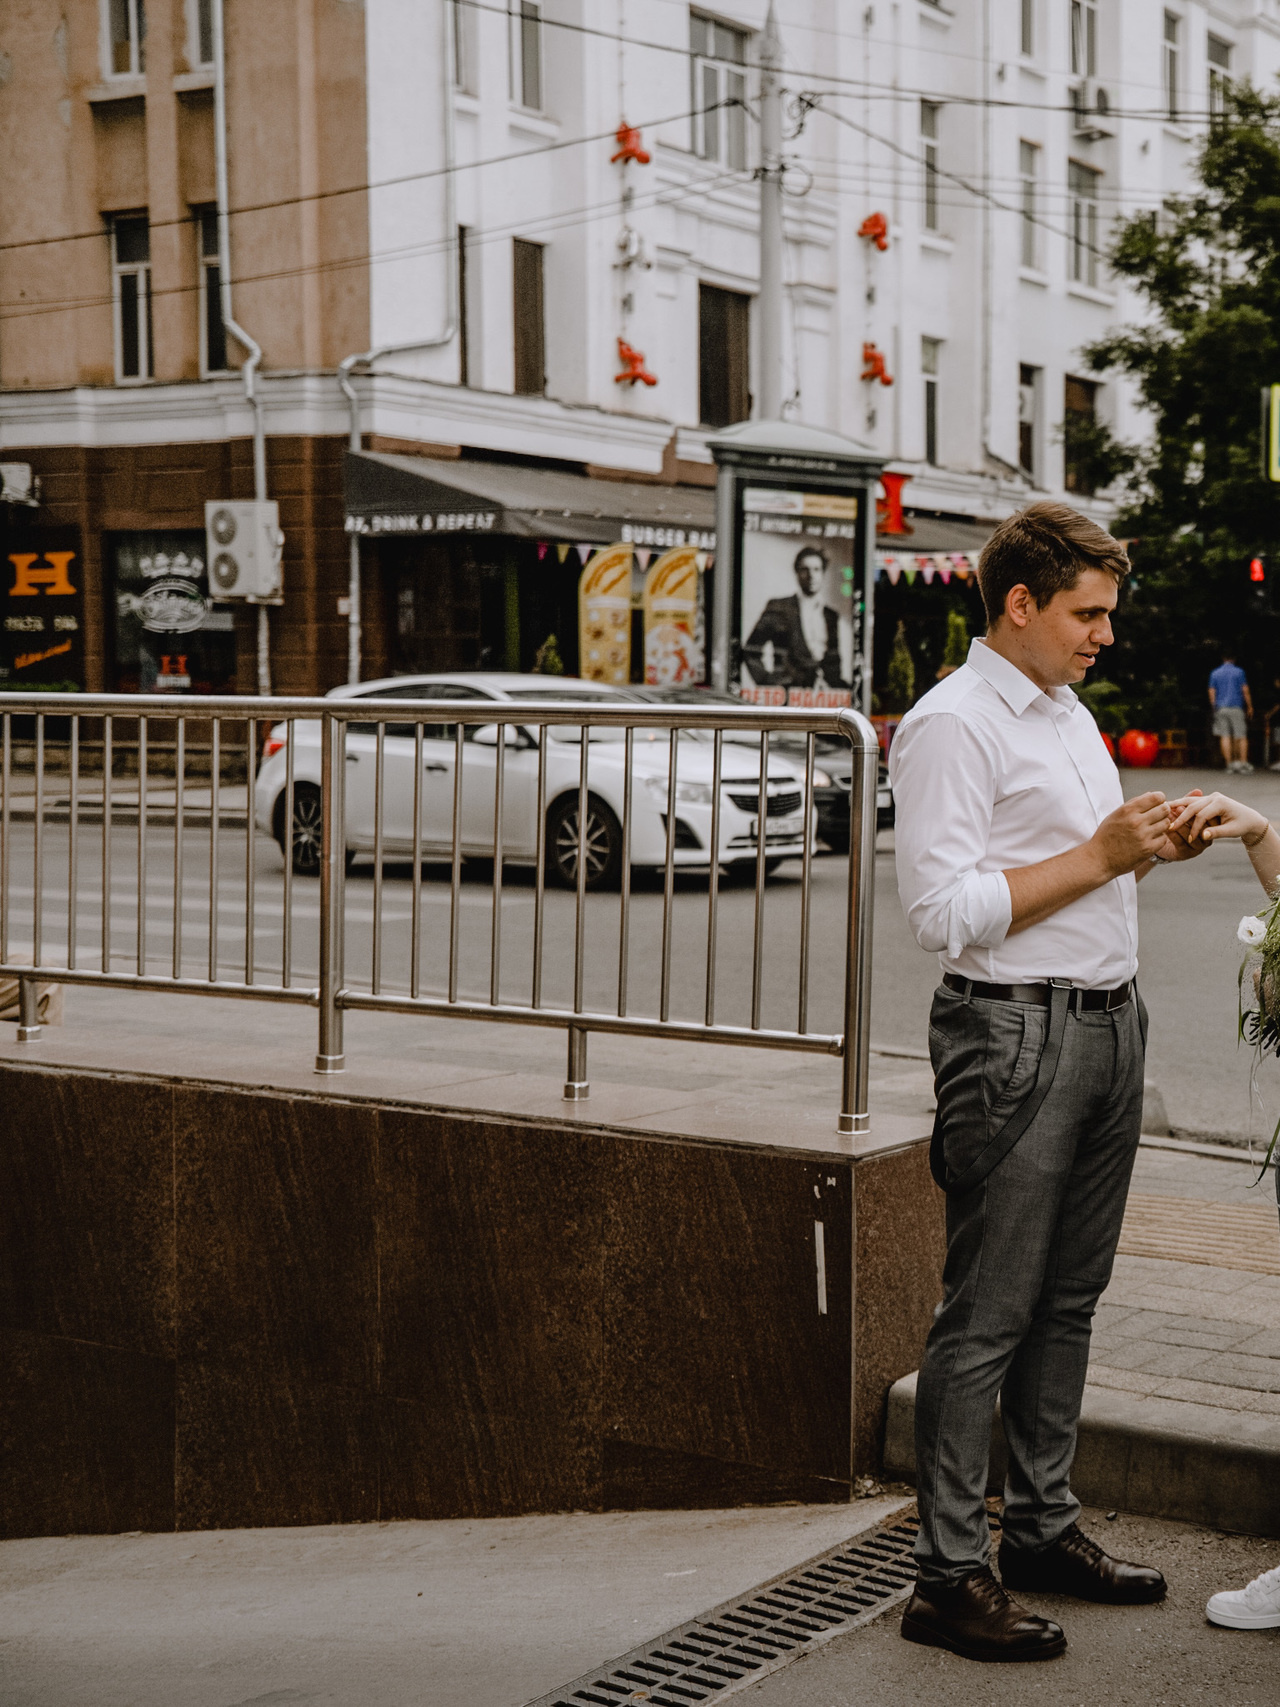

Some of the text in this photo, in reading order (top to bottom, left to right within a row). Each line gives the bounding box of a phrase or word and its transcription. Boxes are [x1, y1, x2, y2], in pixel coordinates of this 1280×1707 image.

[372, 514, 419, 532] DRINK
[436, 512, 496, 530] REPEAT
[621, 524, 686, 548] BURGER
